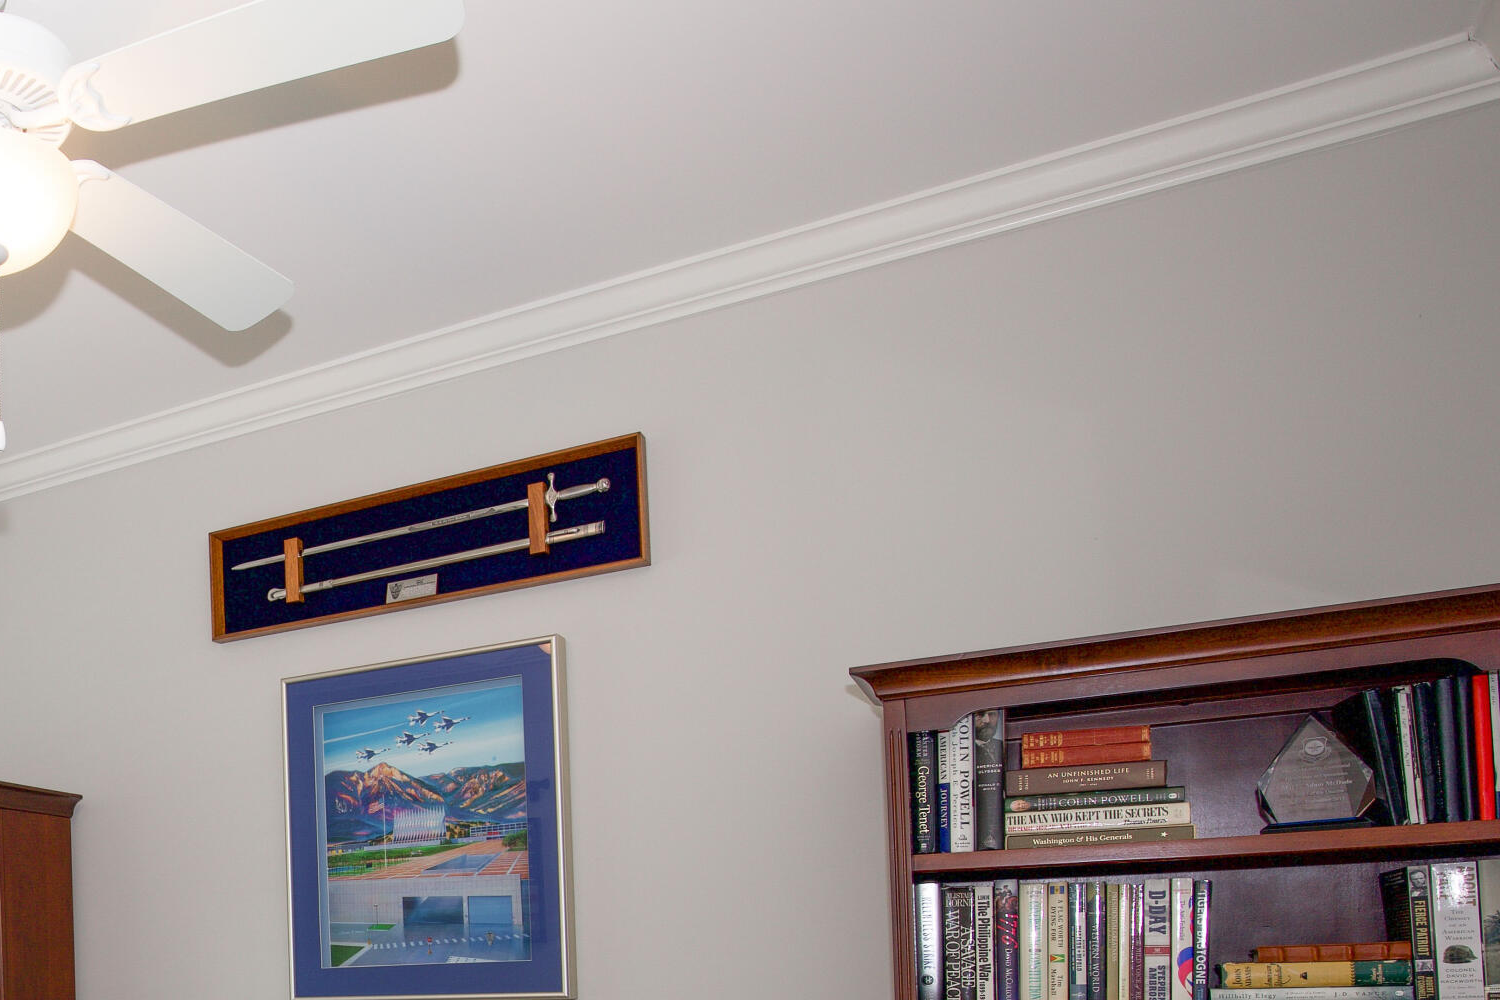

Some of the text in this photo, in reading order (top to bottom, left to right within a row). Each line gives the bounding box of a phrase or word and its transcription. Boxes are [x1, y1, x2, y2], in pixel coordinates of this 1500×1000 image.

[939, 735, 948, 829] AMERICAN JOURNEY
[1061, 769, 1111, 777] UNFINISHED
[915, 766, 932, 835] George Tenet
[959, 770, 971, 829] POWELL
[1007, 806, 1169, 826] THE MAN WHO KEPT THE SECRETS
[1058, 793, 1152, 807] COLIN POWELL
[1032, 833, 1133, 846] Washington His Generals
[946, 909, 960, 940] WAR
[1148, 890, 1167, 935] D-DAY
[1413, 899, 1429, 956] FIERCE PATRIOT
[976, 900, 991, 982] The Philippine War
[997, 913, 1019, 949] 1776
[945, 941, 960, 961] OF
[961, 939, 976, 988] SAVAGE
[1092, 963, 1100, 993] WORLD
[1157, 964, 1166, 1000] STEPHEN
